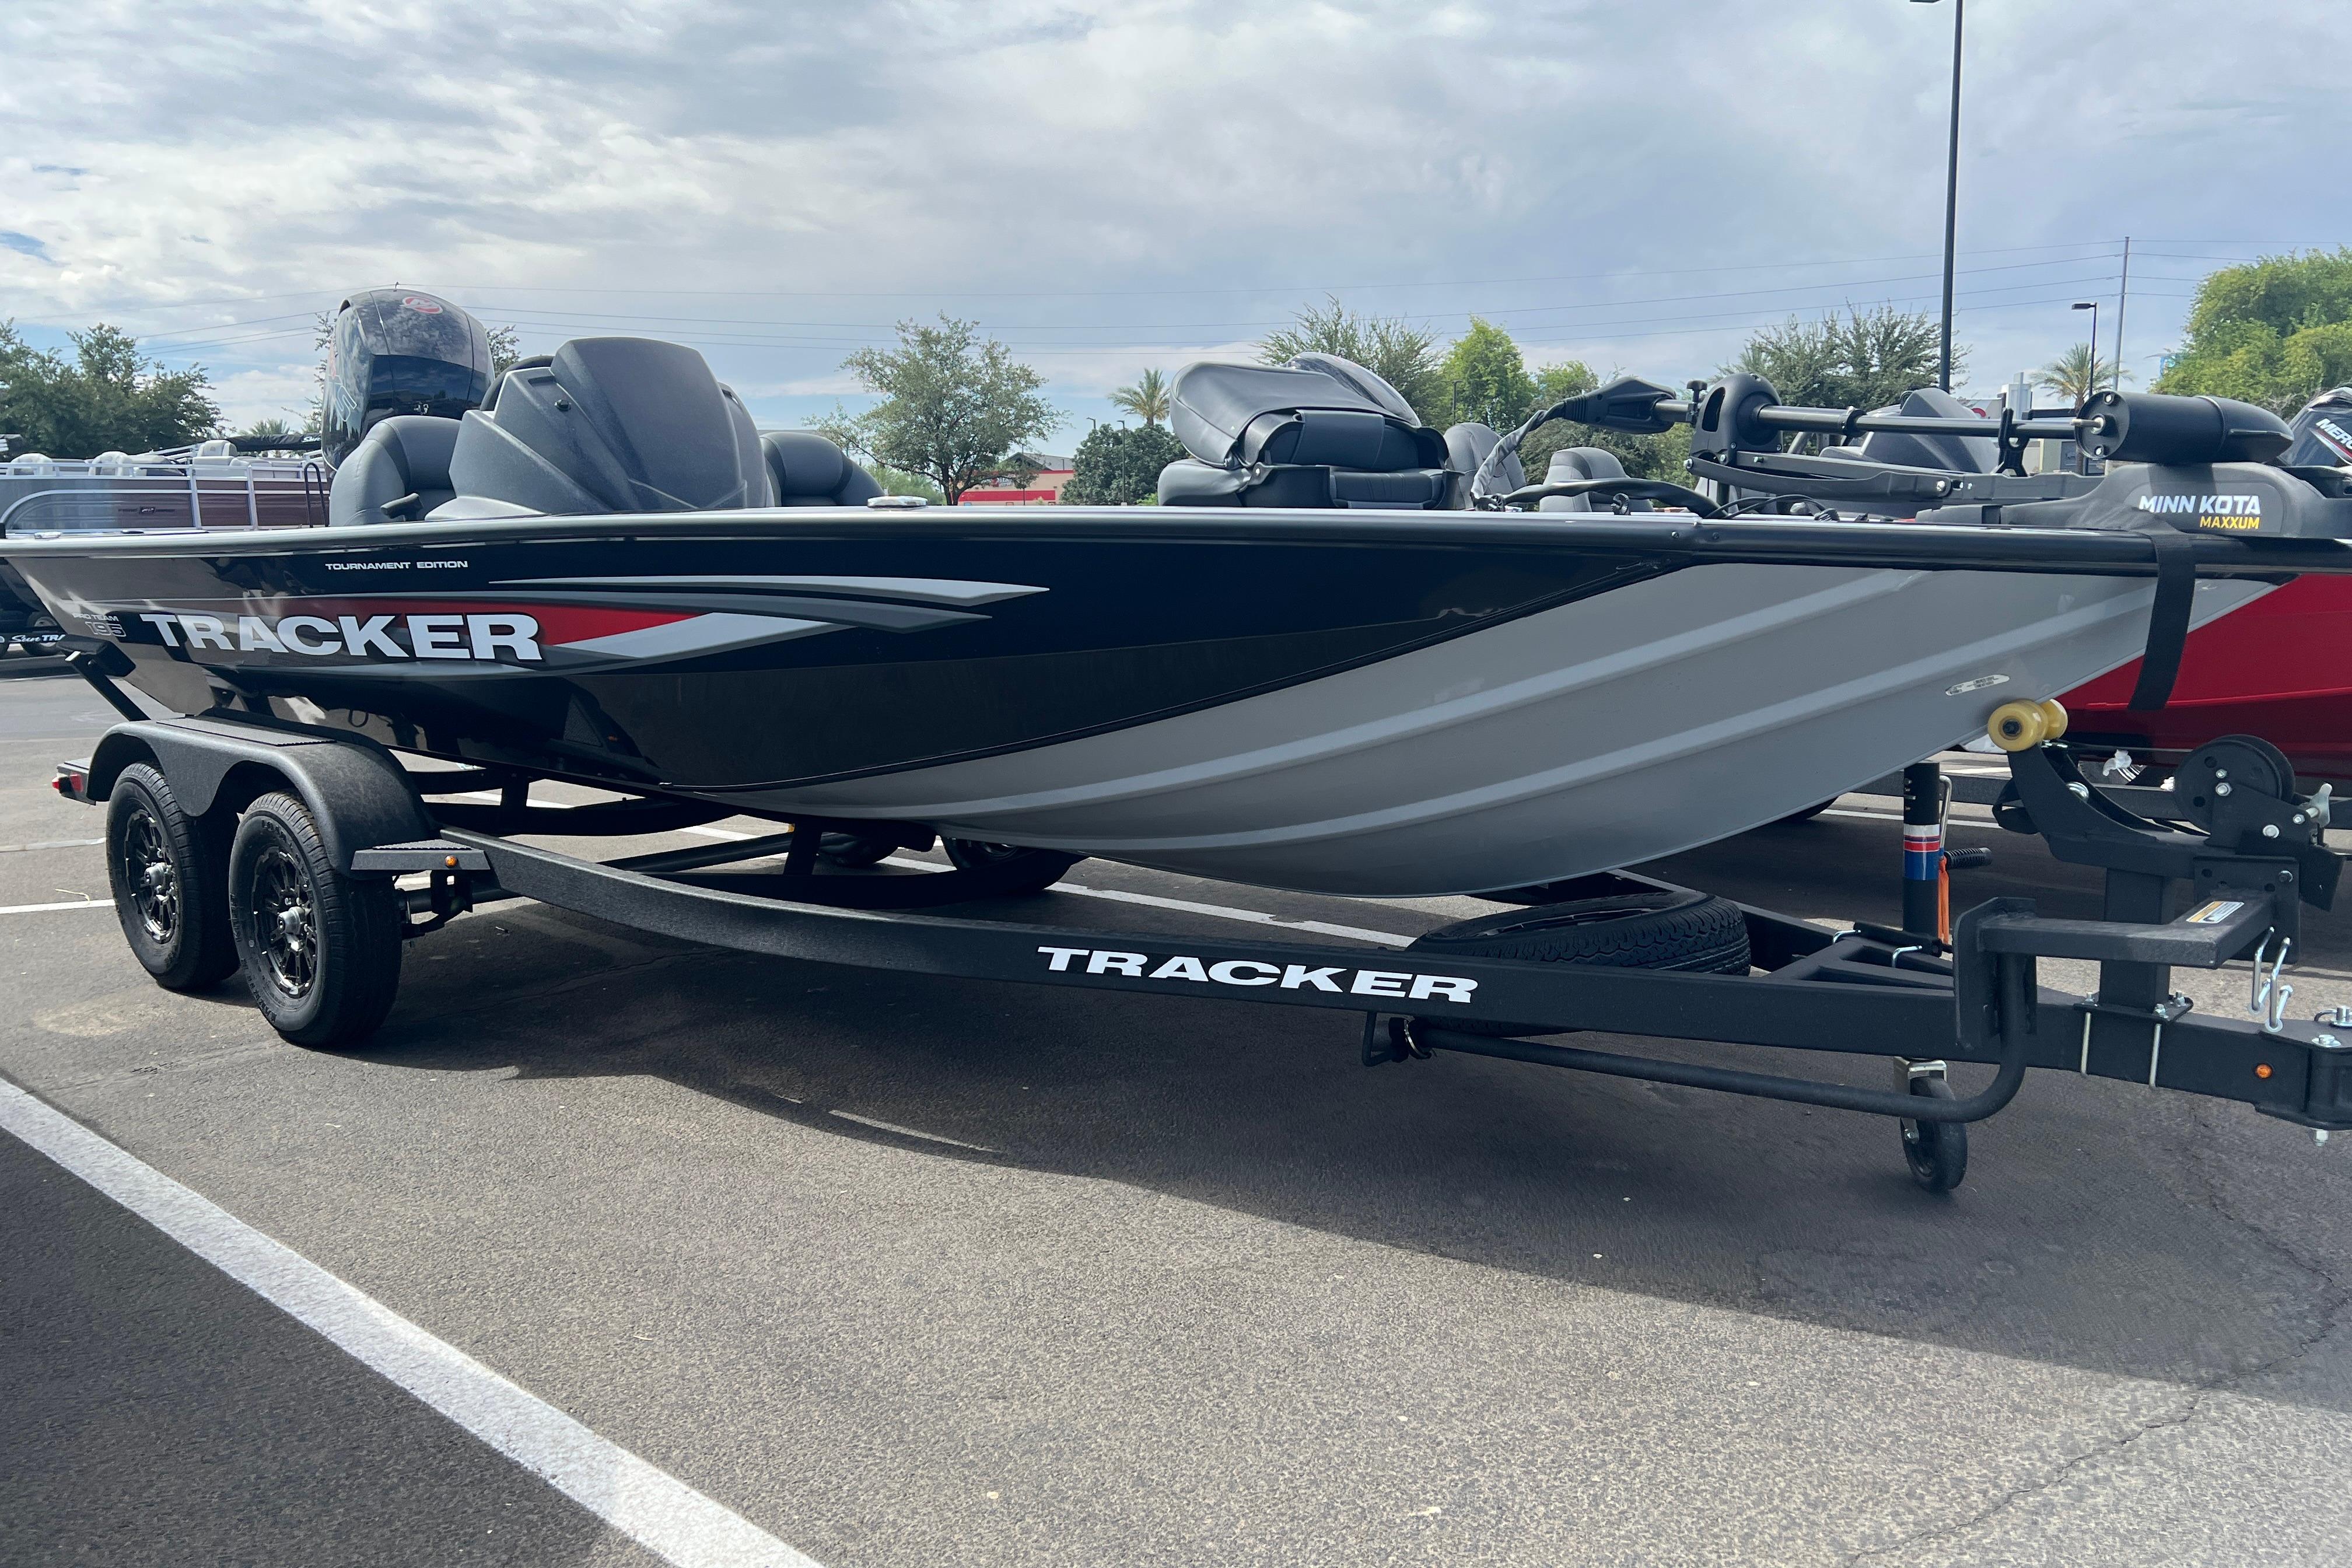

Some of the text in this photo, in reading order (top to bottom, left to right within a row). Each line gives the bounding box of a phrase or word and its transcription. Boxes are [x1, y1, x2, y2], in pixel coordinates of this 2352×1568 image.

[2139, 495, 2261, 514] MINN KOTA
[2199, 516, 2260, 530] MAXXUM
[325, 561, 468, 570] TOURNAMENT EDITION
[85, 621, 127, 637] 195
[139, 614, 543, 660] TRACKER
[1037, 946, 1478, 1003] TRACKER
